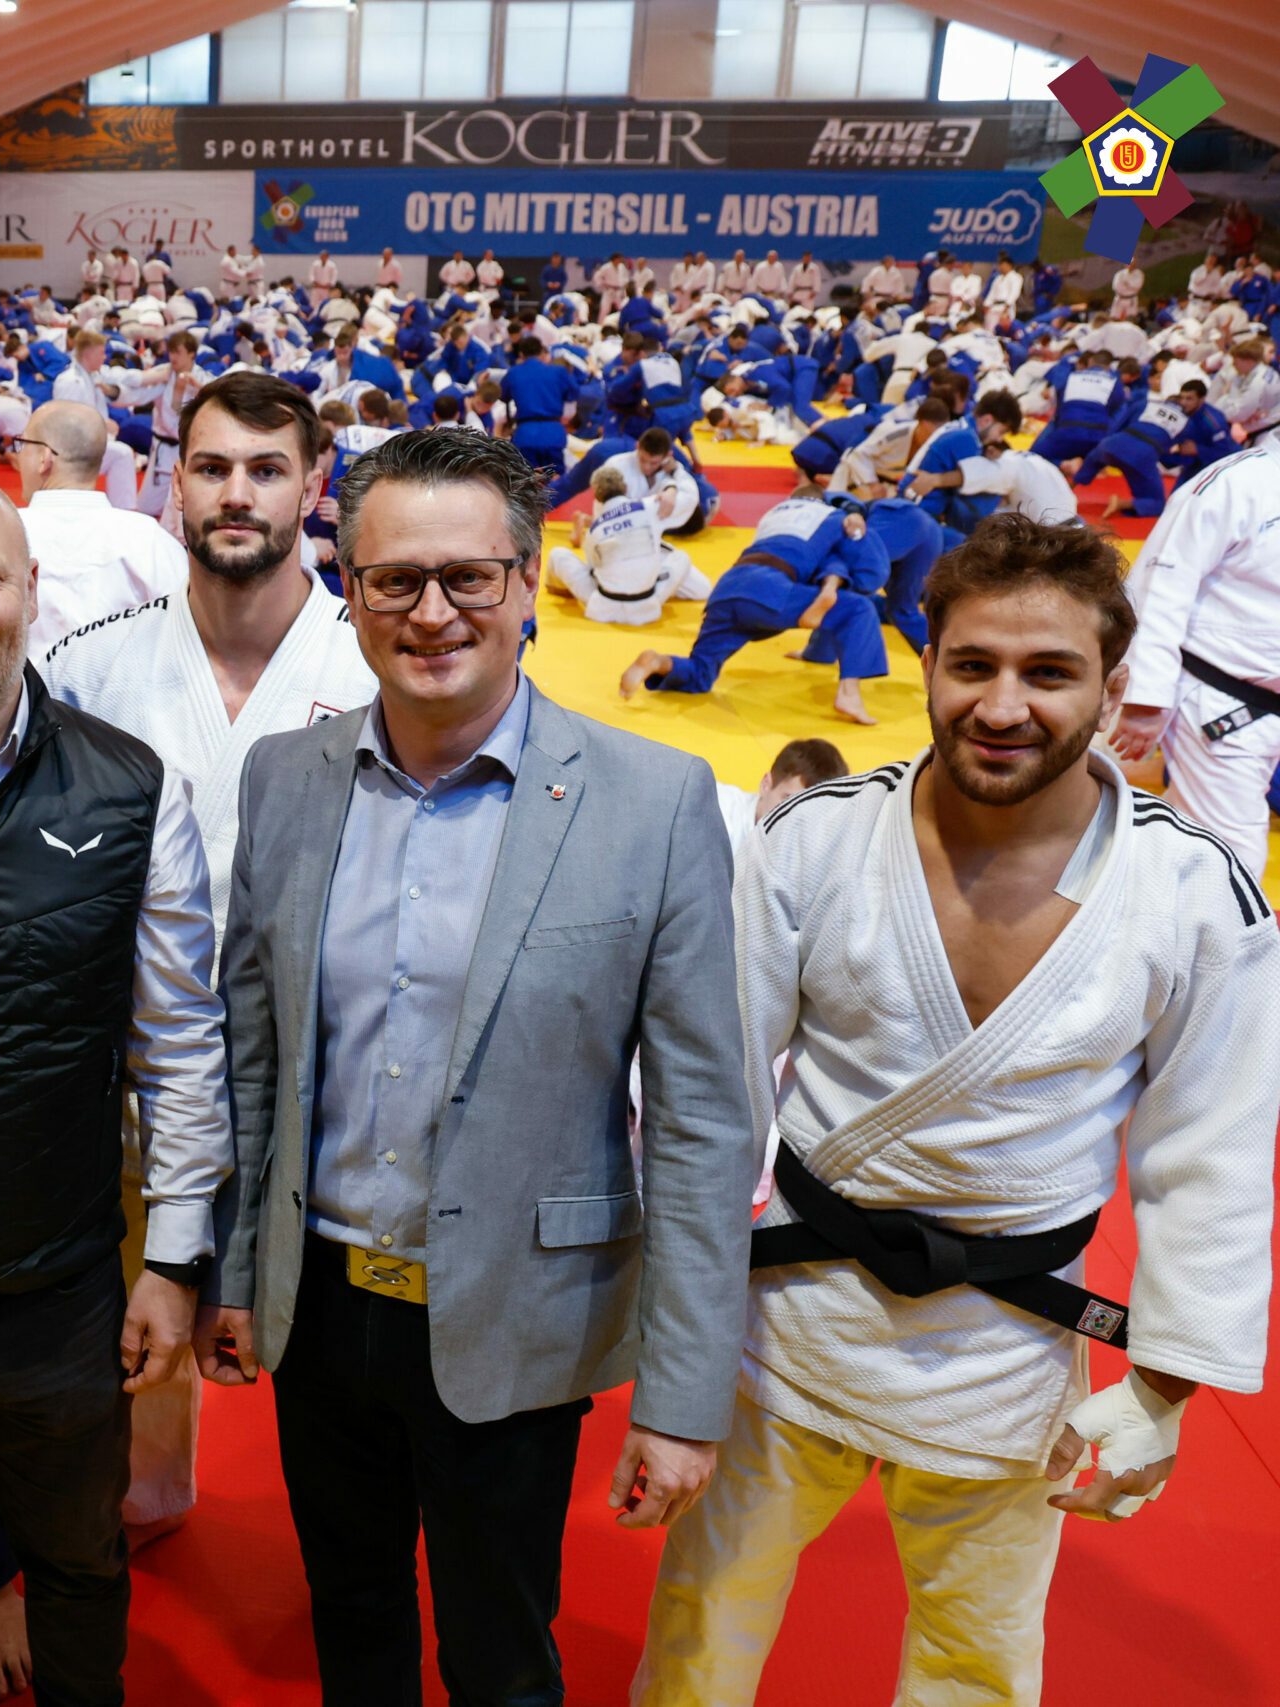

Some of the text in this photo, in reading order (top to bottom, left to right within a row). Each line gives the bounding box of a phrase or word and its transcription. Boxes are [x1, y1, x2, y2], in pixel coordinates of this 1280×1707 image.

[204, 109, 726, 165] SPORTHOTEL KOGLER
[818, 118, 935, 140] ACTIVE
[810, 139, 927, 157] FITNESS
[405, 190, 476, 233] OTC
[483, 191, 689, 236] MITTERSILL
[716, 194, 879, 237] AUSTRIA
[928, 207, 1021, 234] JUDO
[66, 212, 221, 254] KOGLER
[941, 232, 1014, 245] AUSTRIA
